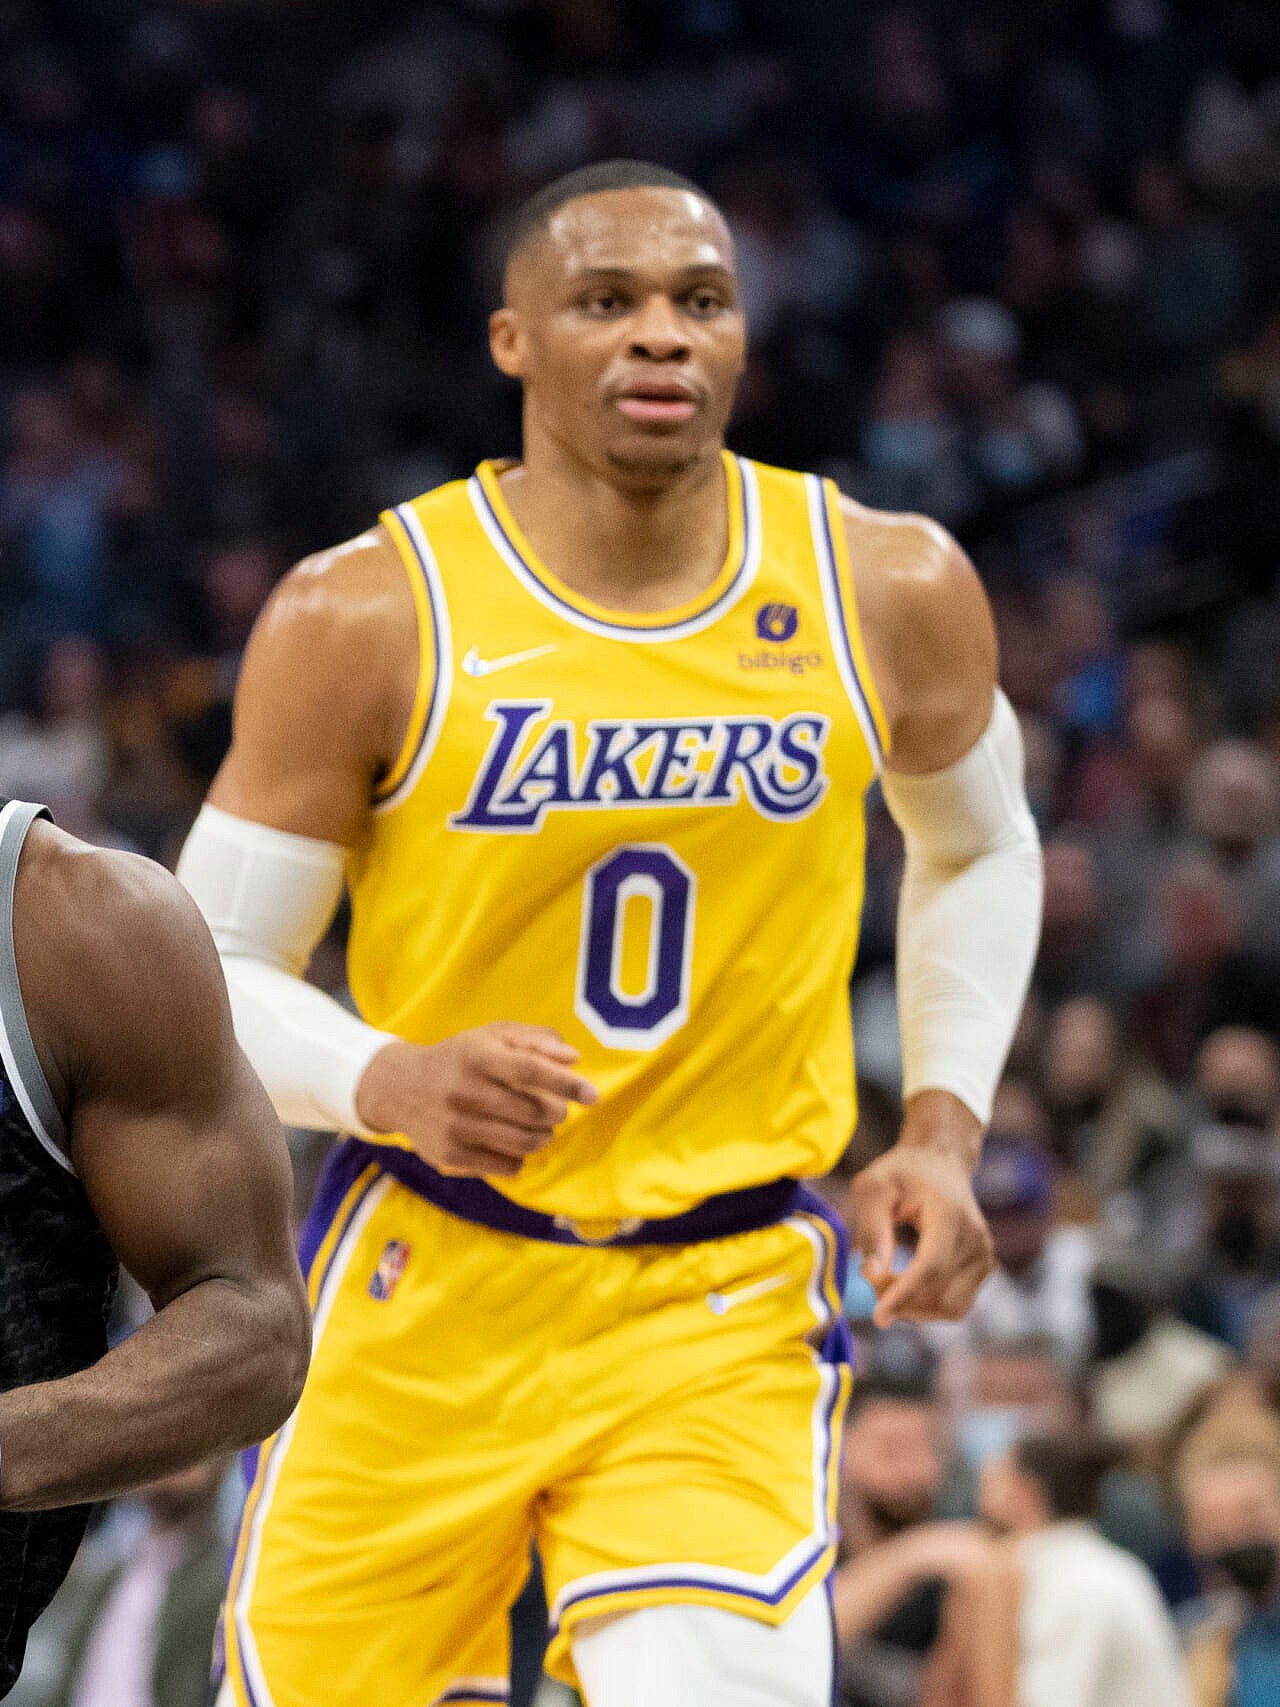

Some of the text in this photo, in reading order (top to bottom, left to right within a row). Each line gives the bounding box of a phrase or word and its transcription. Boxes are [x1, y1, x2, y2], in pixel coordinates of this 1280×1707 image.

[737, 650, 823, 676] bibigo
[446, 698, 831, 834] LAKERS
[575, 842, 697, 1051] 0
